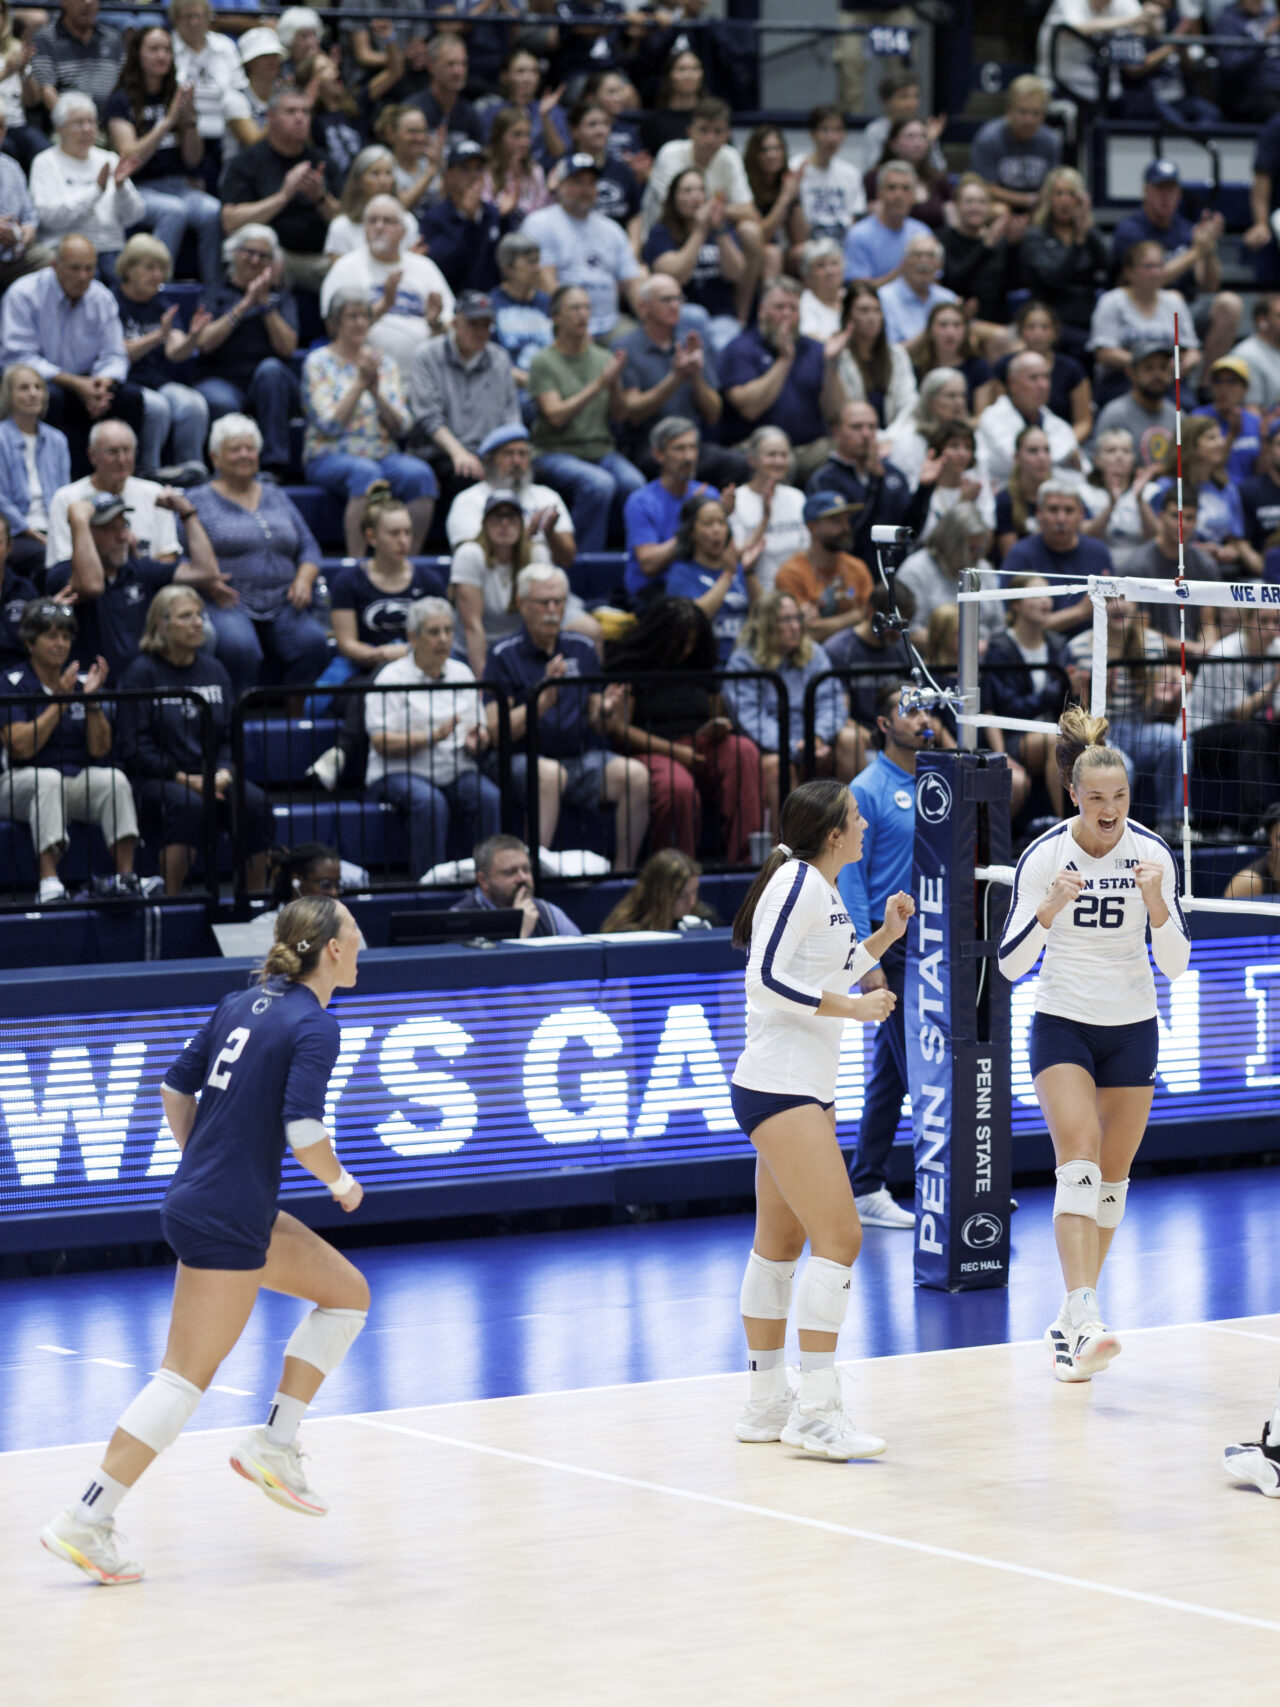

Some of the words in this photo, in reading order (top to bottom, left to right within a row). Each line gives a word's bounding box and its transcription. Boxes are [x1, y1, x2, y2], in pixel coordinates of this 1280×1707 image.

[1230, 585, 1256, 602] WE
[1073, 895, 1125, 929] 26
[1100, 878, 1137, 890] STAT
[830, 913, 851, 926] PEN
[919, 875, 944, 1064] STATE
[207, 1027, 250, 1091] 2
[976, 1058, 992, 1120] PENN
[0, 1016, 479, 1186] WS
[916, 1084, 946, 1255] PENN
[975, 1125, 992, 1193] STATE
[960, 1262, 979, 1272] REC
[980, 1260, 1003, 1270] HALL
